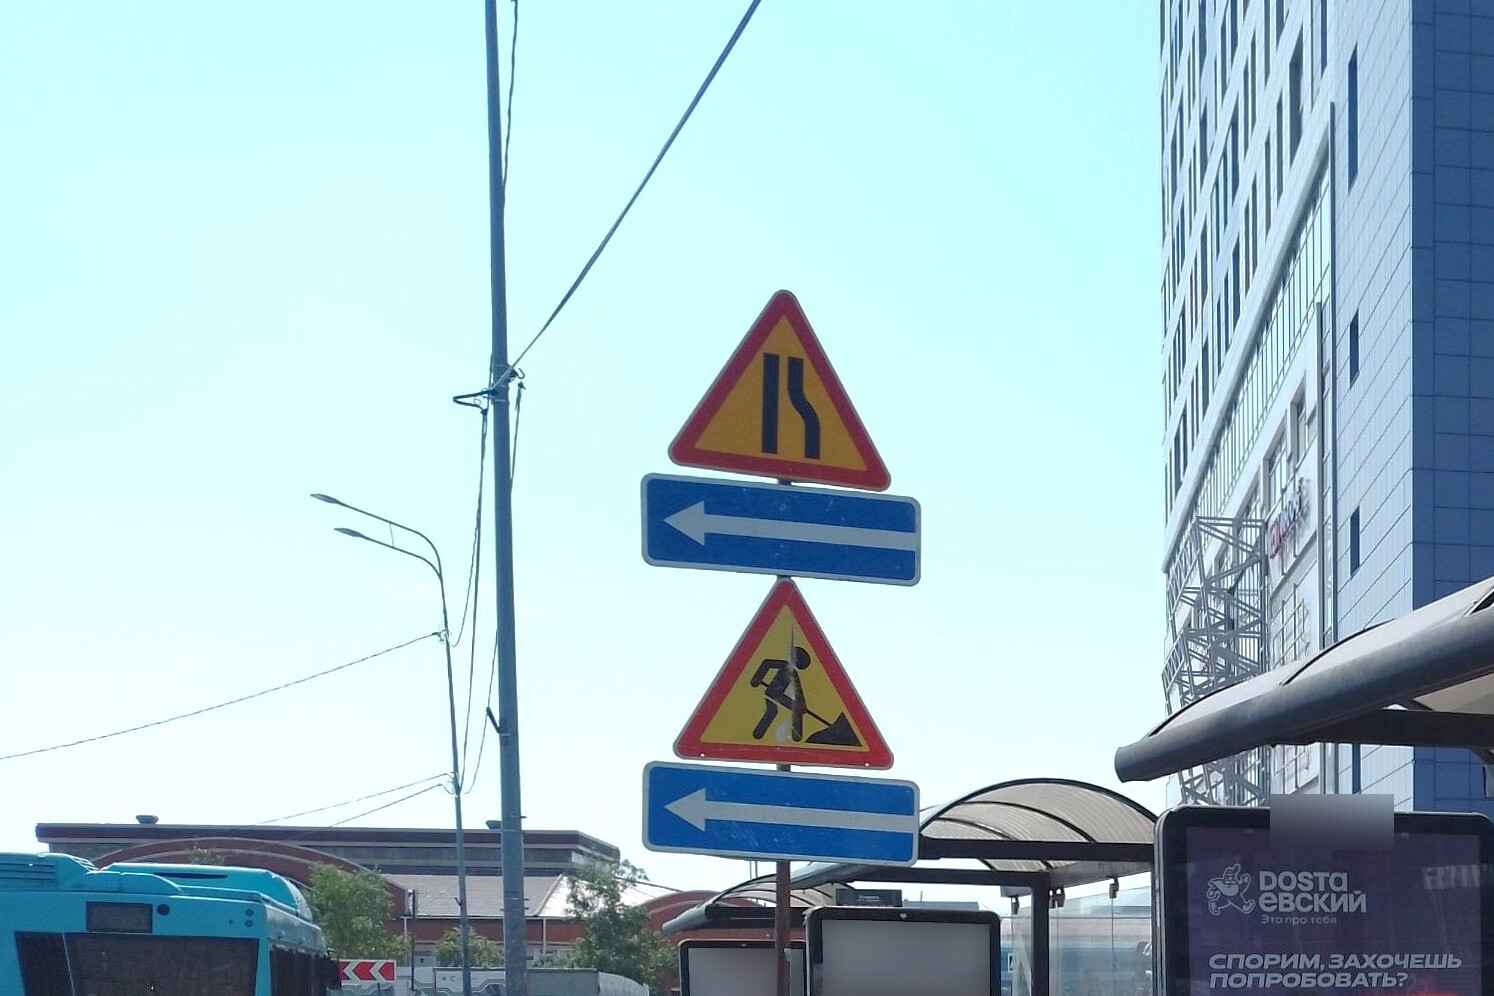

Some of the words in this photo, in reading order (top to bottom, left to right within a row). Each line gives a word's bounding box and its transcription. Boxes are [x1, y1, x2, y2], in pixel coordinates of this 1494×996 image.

[1261, 914, 1283, 925] Это
[1285, 915, 1308, 927] про
[1311, 914, 1337, 925] тебя
[1209, 953, 1325, 972] СПОРИМ,
[1328, 953, 1463, 969] ЗАХОЧЕШЬ
[1209, 972, 1408, 988] ПОПРОБОВАТЬ?
